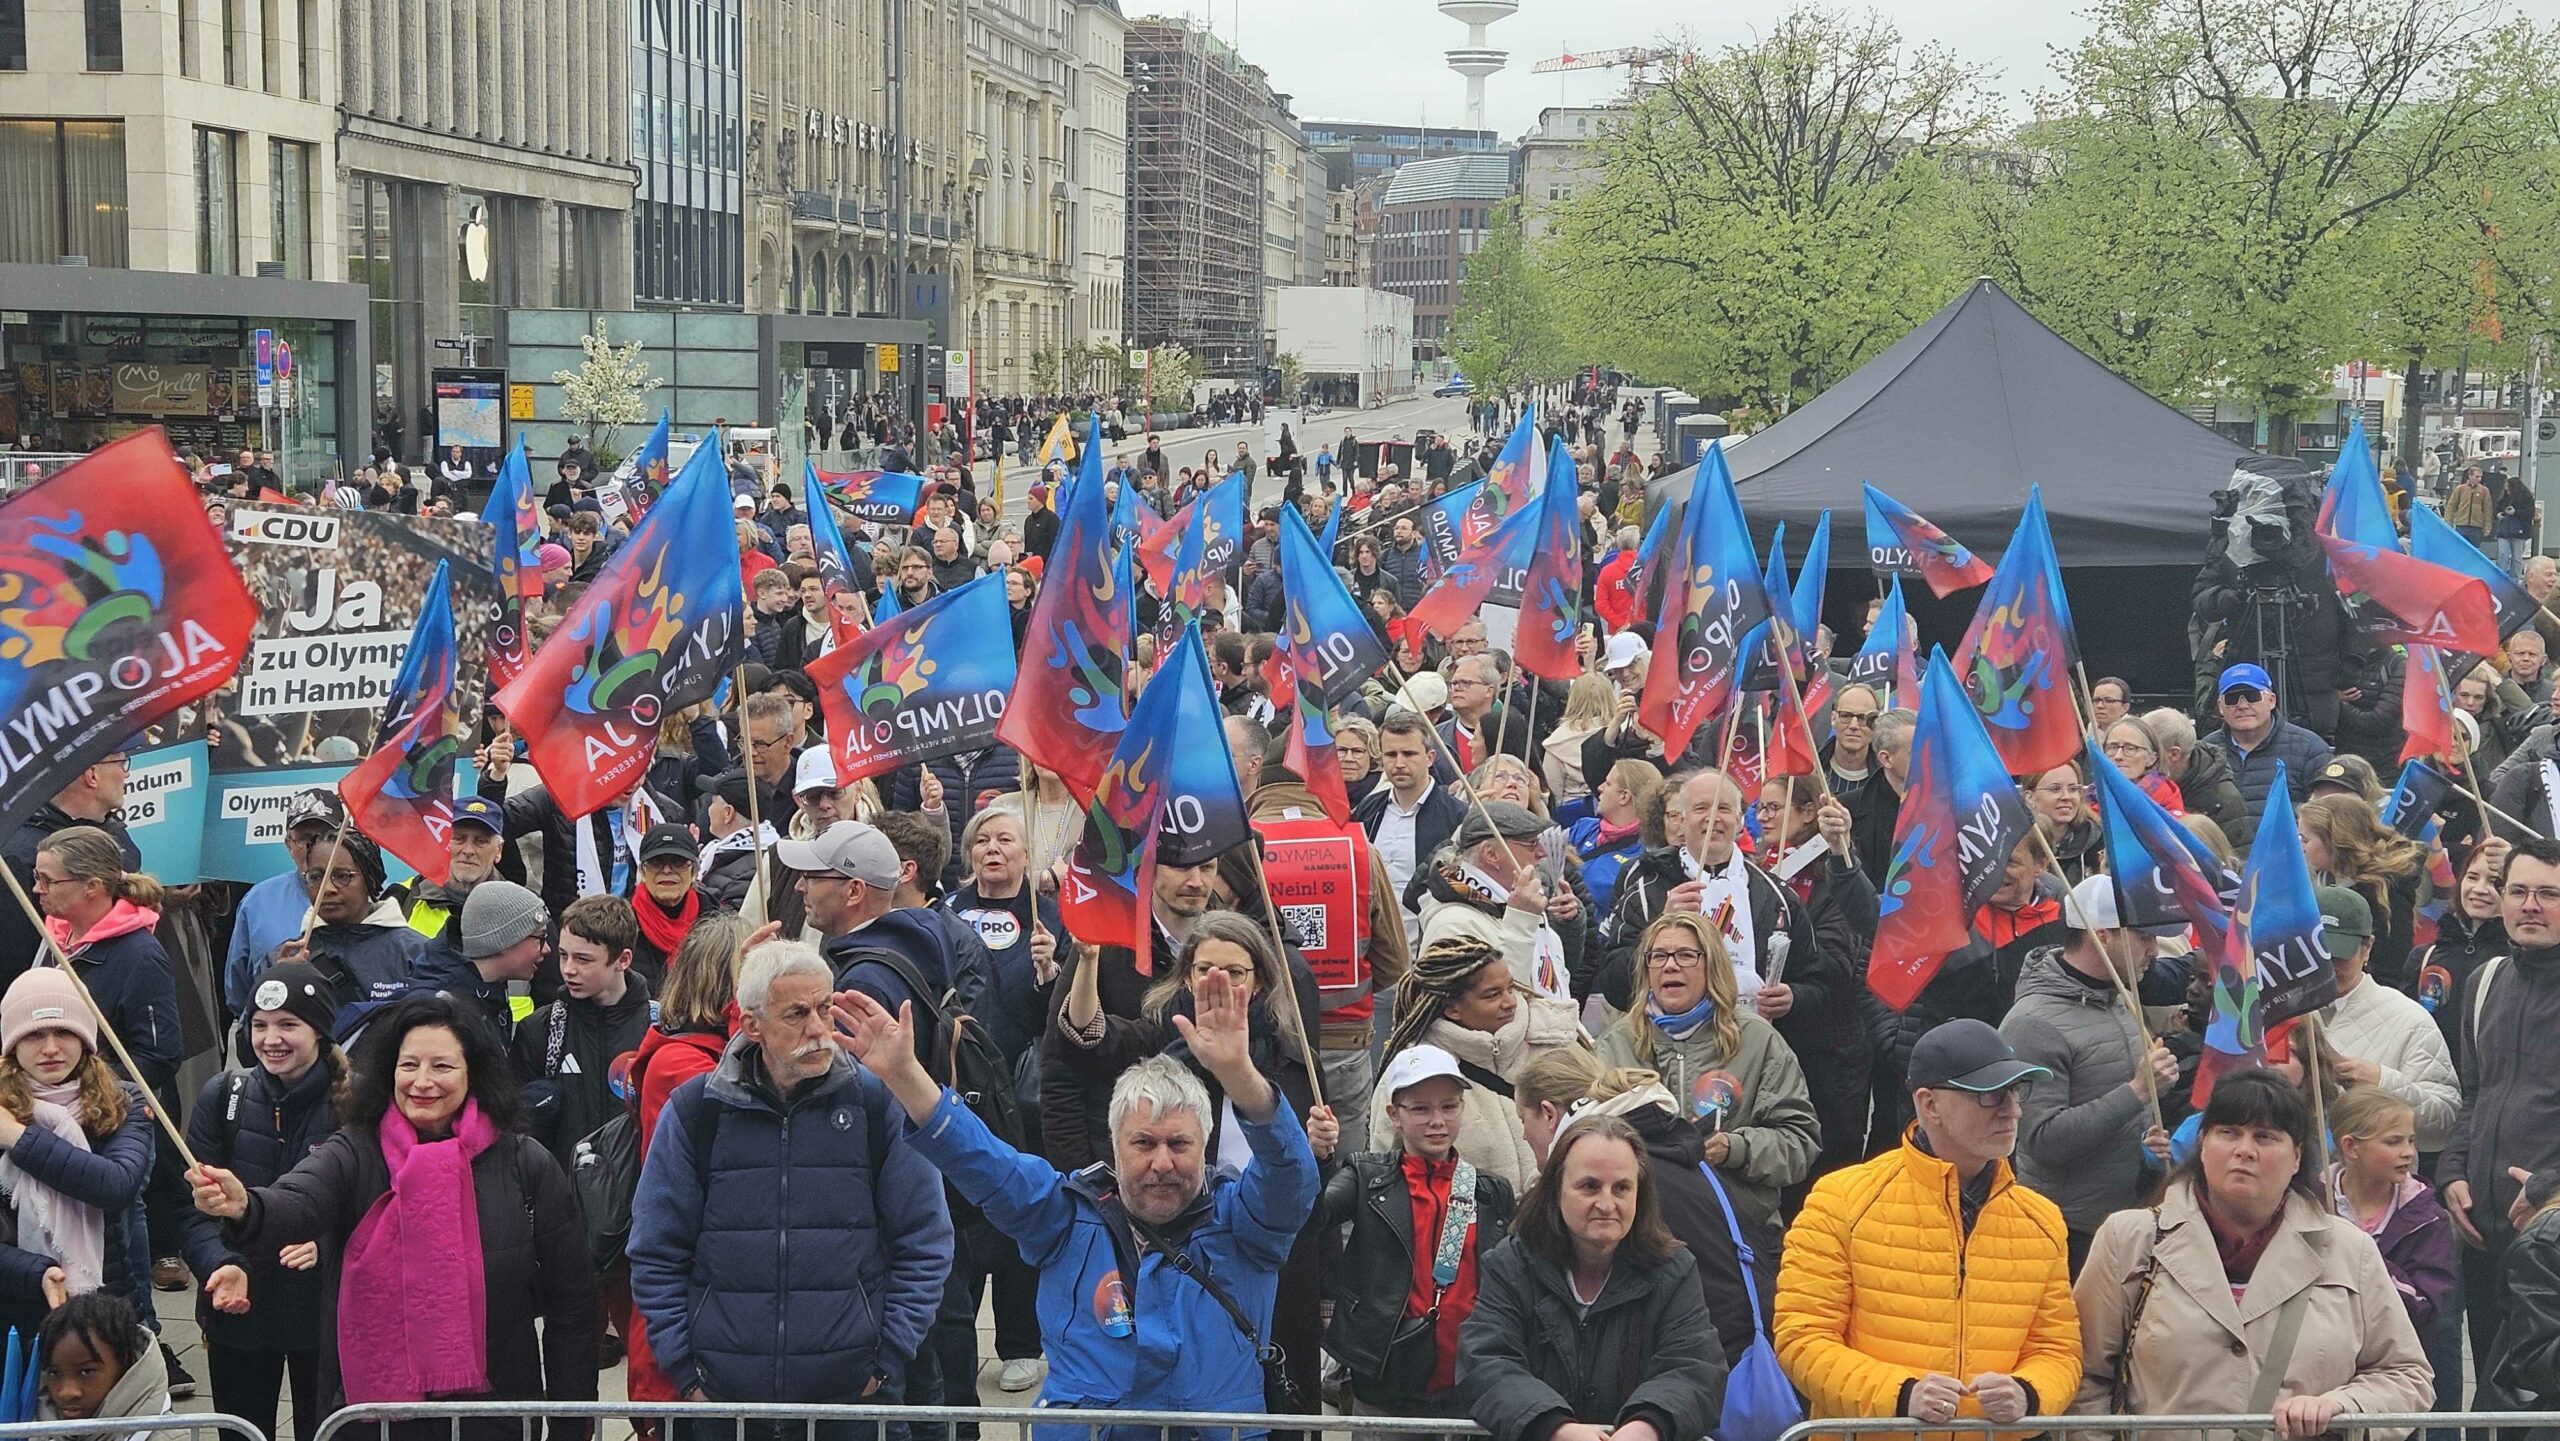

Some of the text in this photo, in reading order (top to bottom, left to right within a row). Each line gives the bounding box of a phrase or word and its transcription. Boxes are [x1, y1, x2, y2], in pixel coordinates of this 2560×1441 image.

[258, 369, 271, 381] TAXI
[261, 516, 335, 543] CDU
[289, 568, 382, 632] Ja
[260, 641, 409, 672] zu Olymp
[250, 675, 398, 707] in Hambu
[124, 769, 182, 794] ndum
[228, 790, 299, 814] Olymp
[253, 823, 283, 838] am
[1264, 848, 1335, 863] OLYMPIA
[1304, 863, 1349, 872] HAMBURG
[1271, 880, 1317, 897] Nein!
[981, 921, 1015, 934] PRO
[1322, 957, 1349, 965] etwas
[226, 1093, 239, 1121] arena
